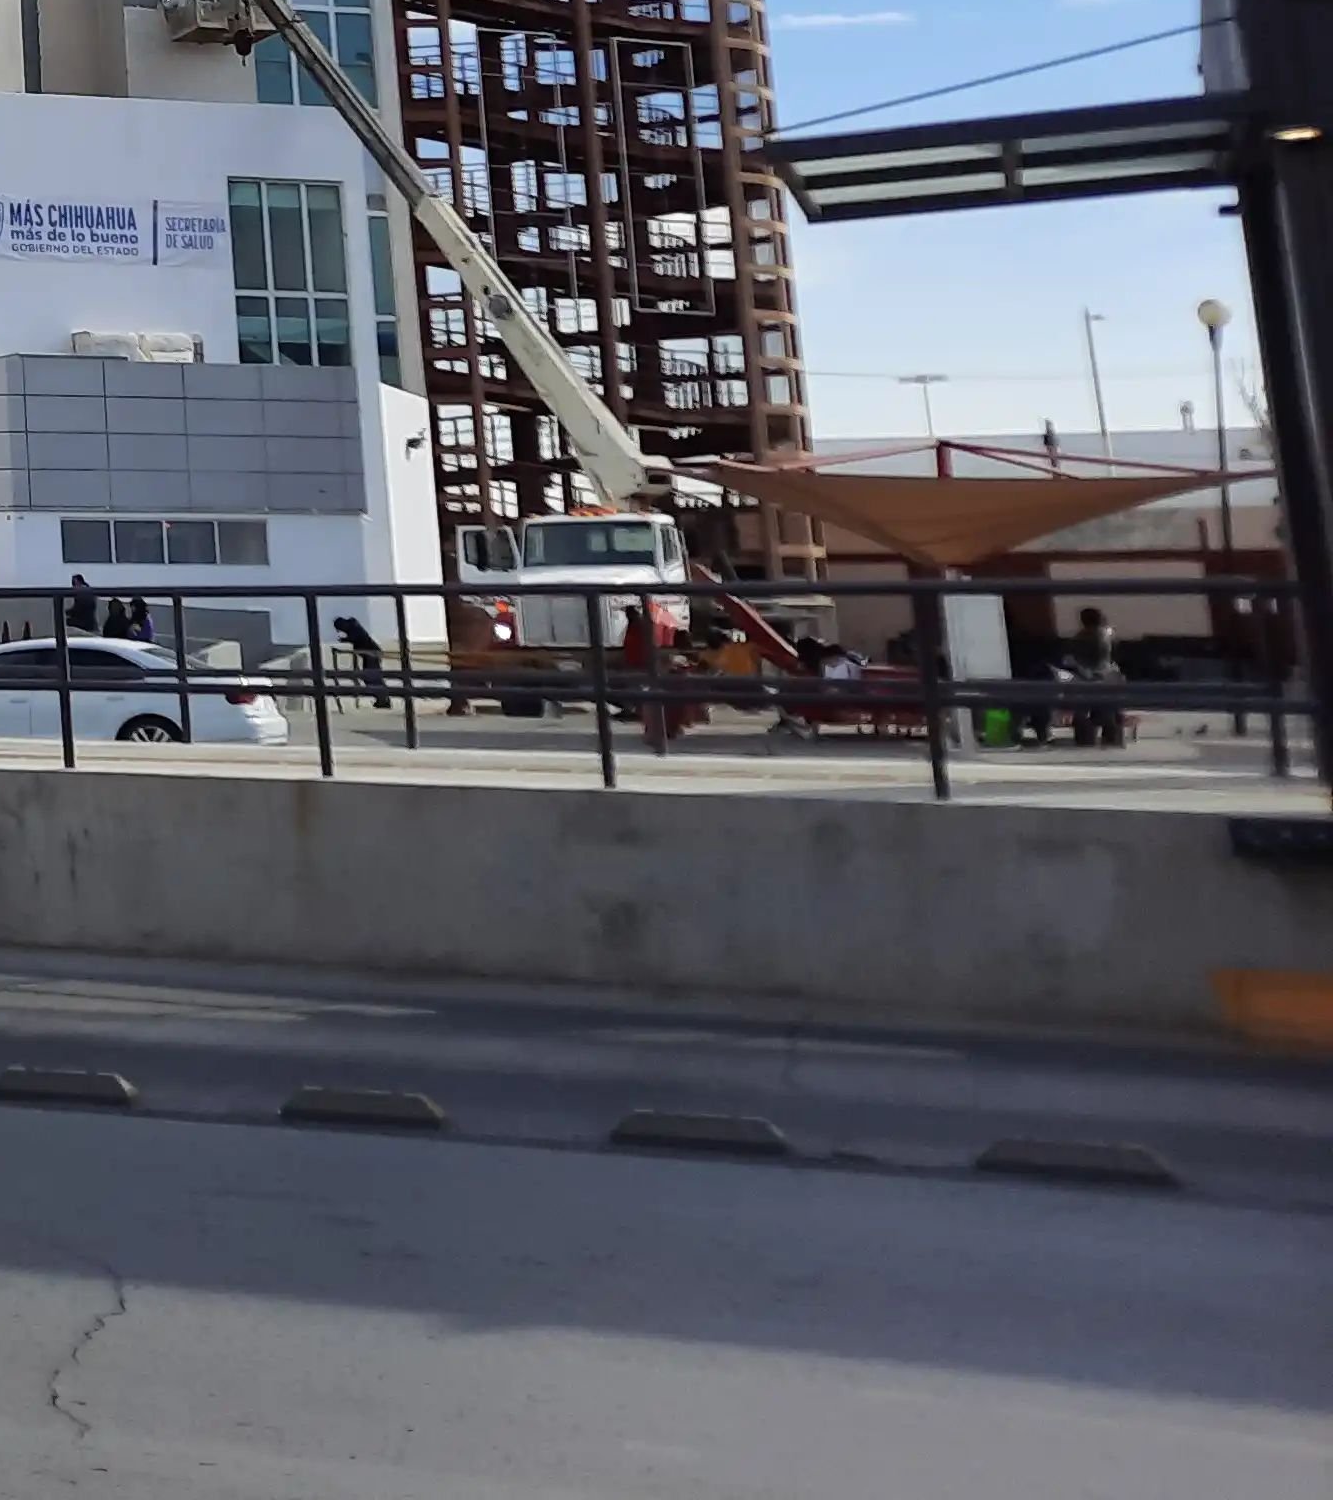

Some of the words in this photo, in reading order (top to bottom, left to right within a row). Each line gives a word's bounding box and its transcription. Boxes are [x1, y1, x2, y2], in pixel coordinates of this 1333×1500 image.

[9, 199, 44, 227] MÁS
[48, 204, 137, 230] CHIHUAHUA
[10, 227, 42, 241] más
[47, 229, 66, 242] de
[71, 229, 85, 243] lo
[90, 230, 139, 245] bueno
[165, 233, 178, 249] DE
[181, 234, 214, 250] SALUD
[11, 243, 70, 254] GOBIERNO
[72, 245, 94, 256] DEL
[96, 246, 139, 257] ESTADO
